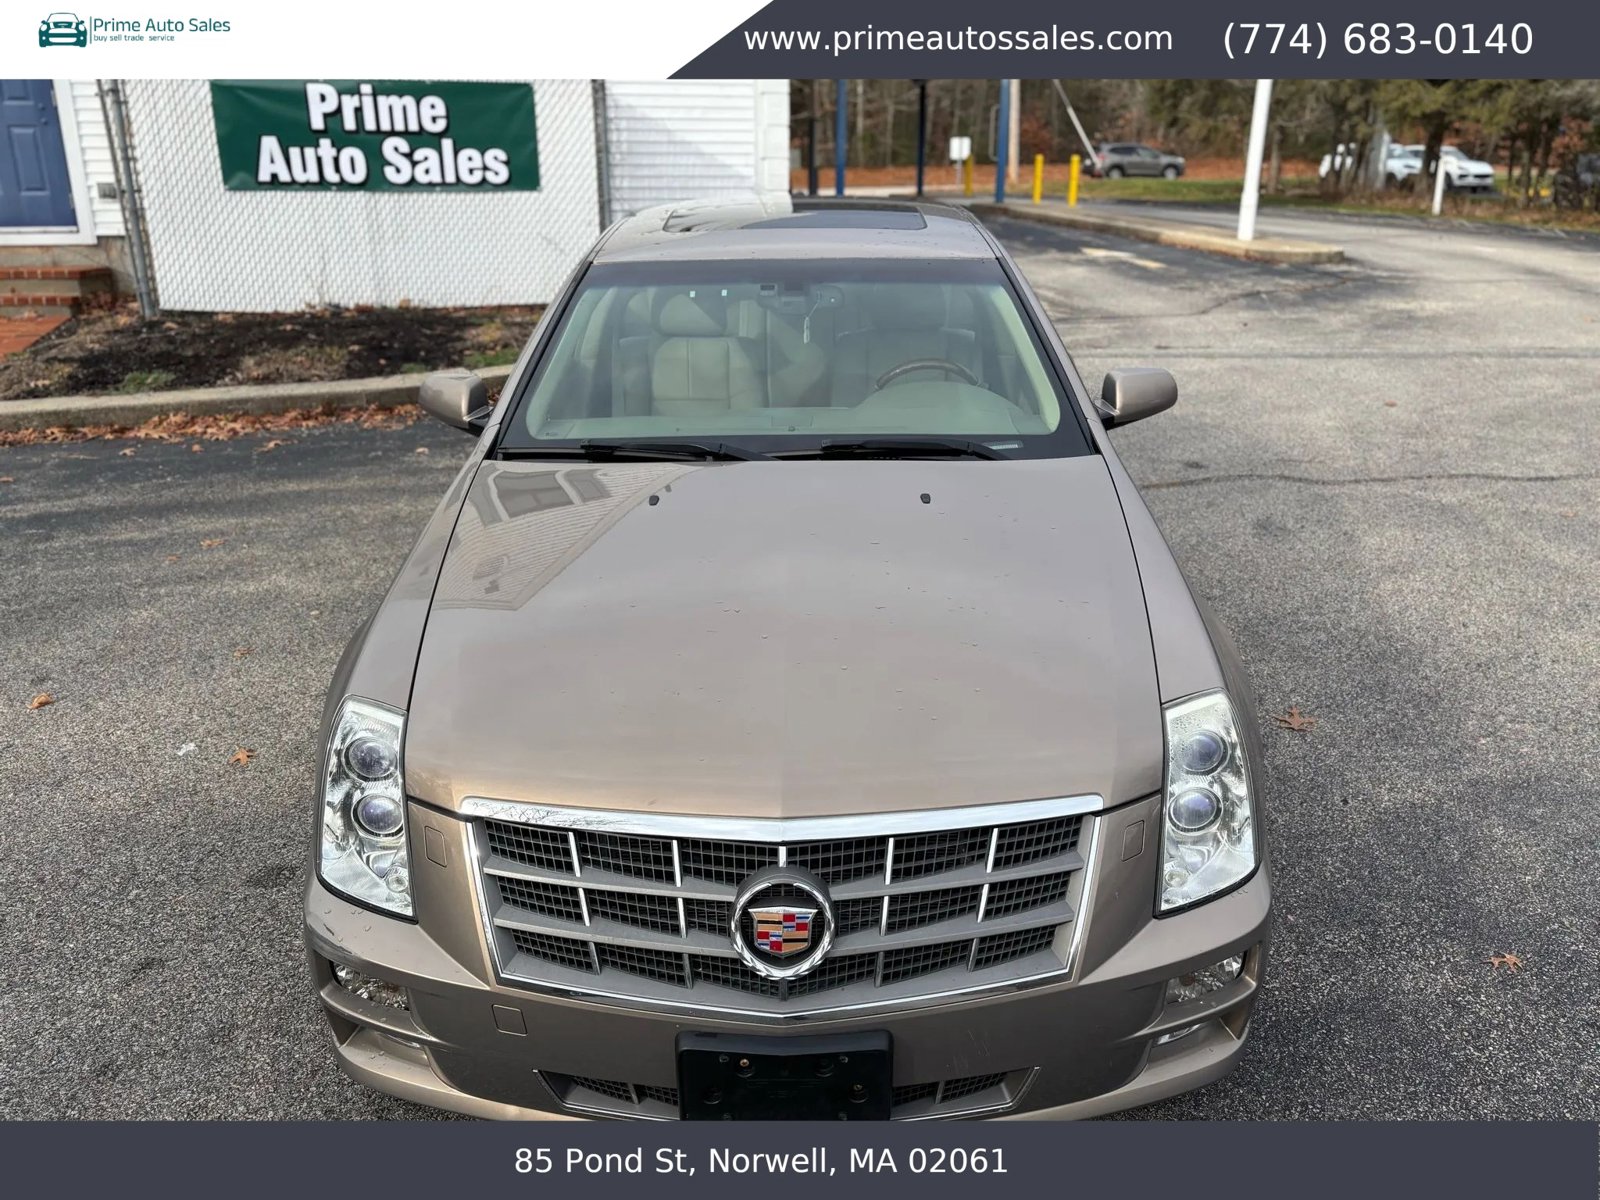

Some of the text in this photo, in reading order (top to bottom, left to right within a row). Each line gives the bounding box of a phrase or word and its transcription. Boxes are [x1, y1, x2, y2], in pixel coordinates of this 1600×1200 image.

[304, 82, 449, 134] Prime
[256, 135, 510, 186] Auto Sales
